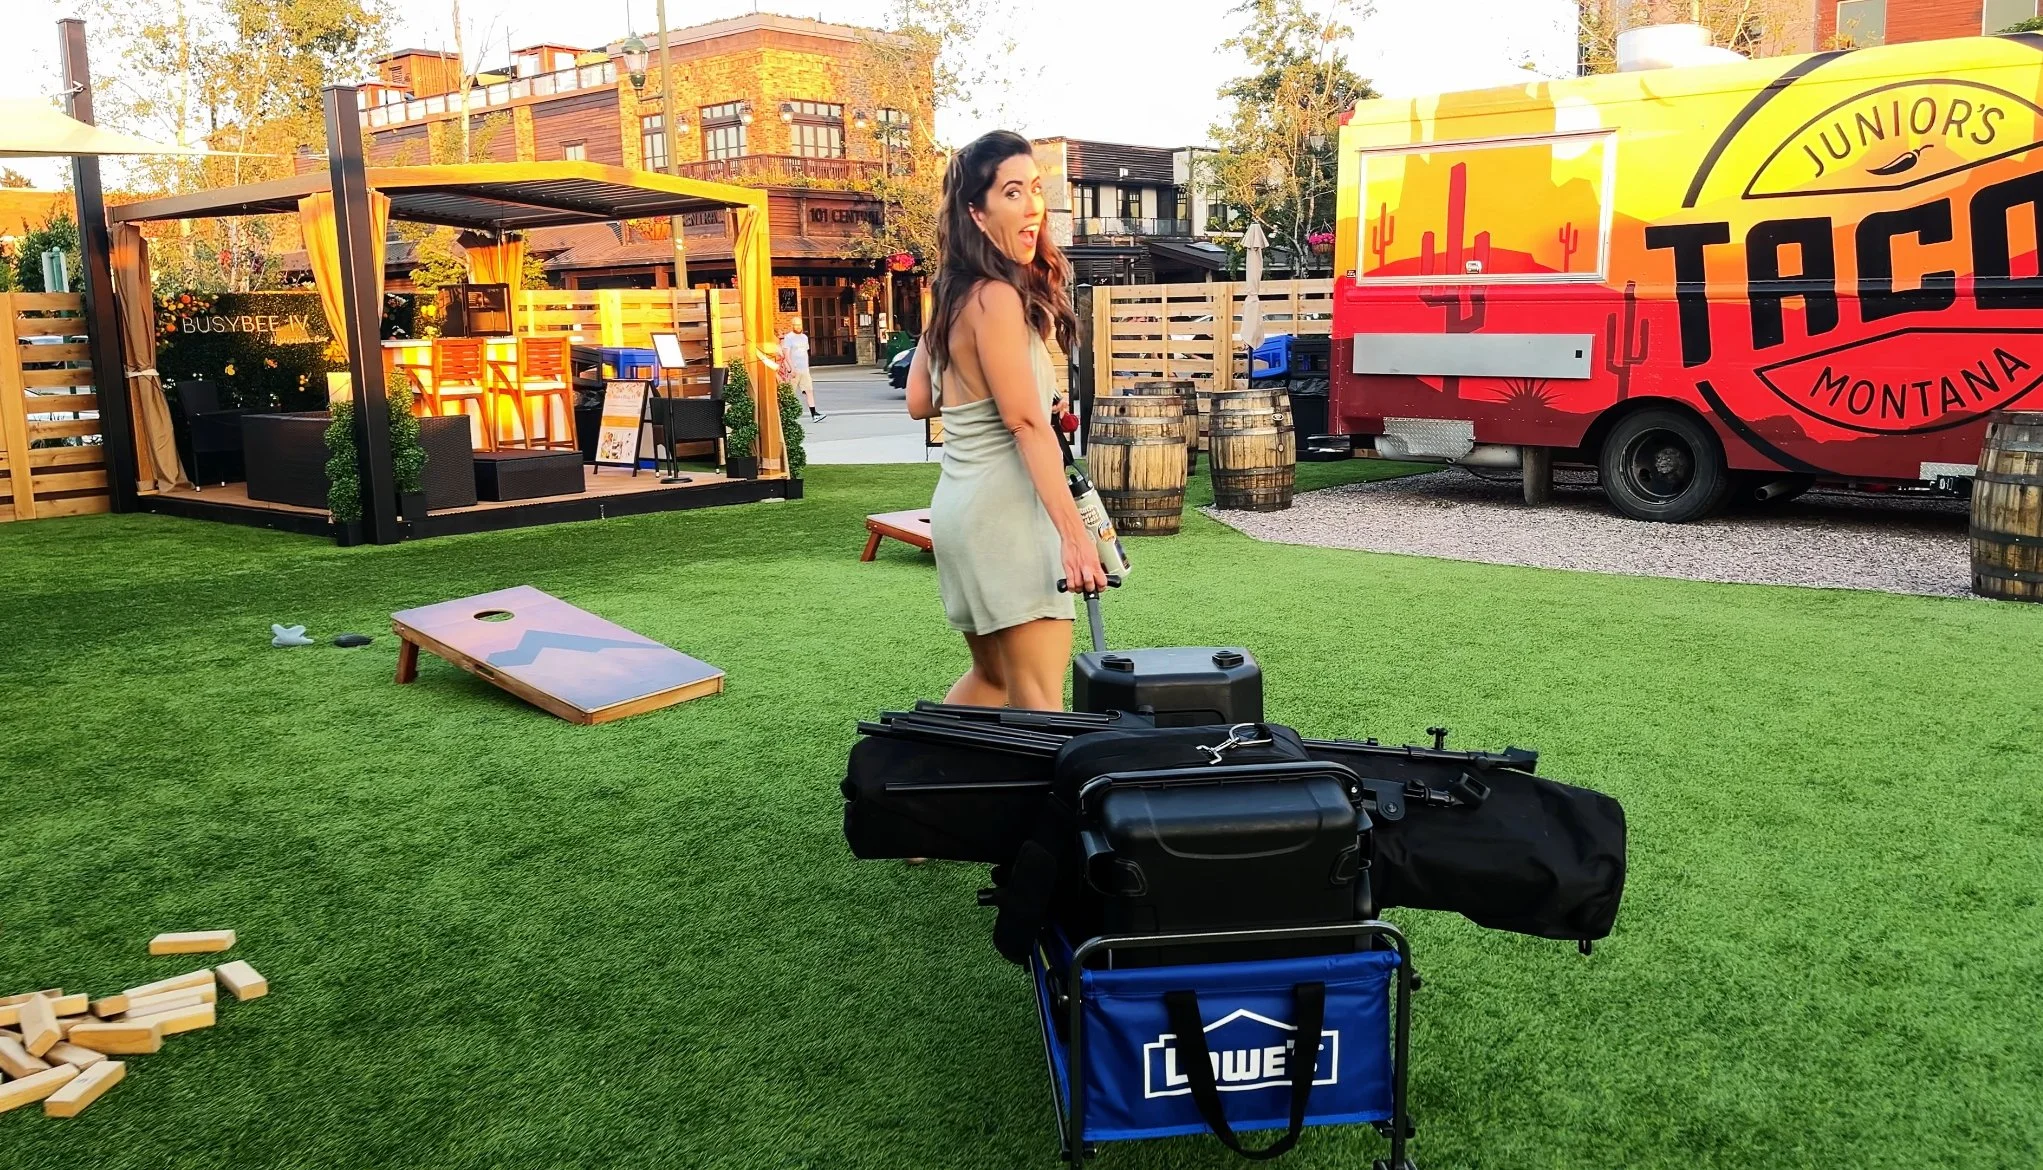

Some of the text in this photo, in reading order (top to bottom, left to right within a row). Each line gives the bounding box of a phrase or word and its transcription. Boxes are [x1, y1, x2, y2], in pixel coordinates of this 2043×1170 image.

[1803, 96, 2006, 178] JUNIOR'S
[809, 207, 828, 223] 101
[182, 314, 309, 334] BUSYBEE IV
[1810, 347, 2031, 420] MONTANA
